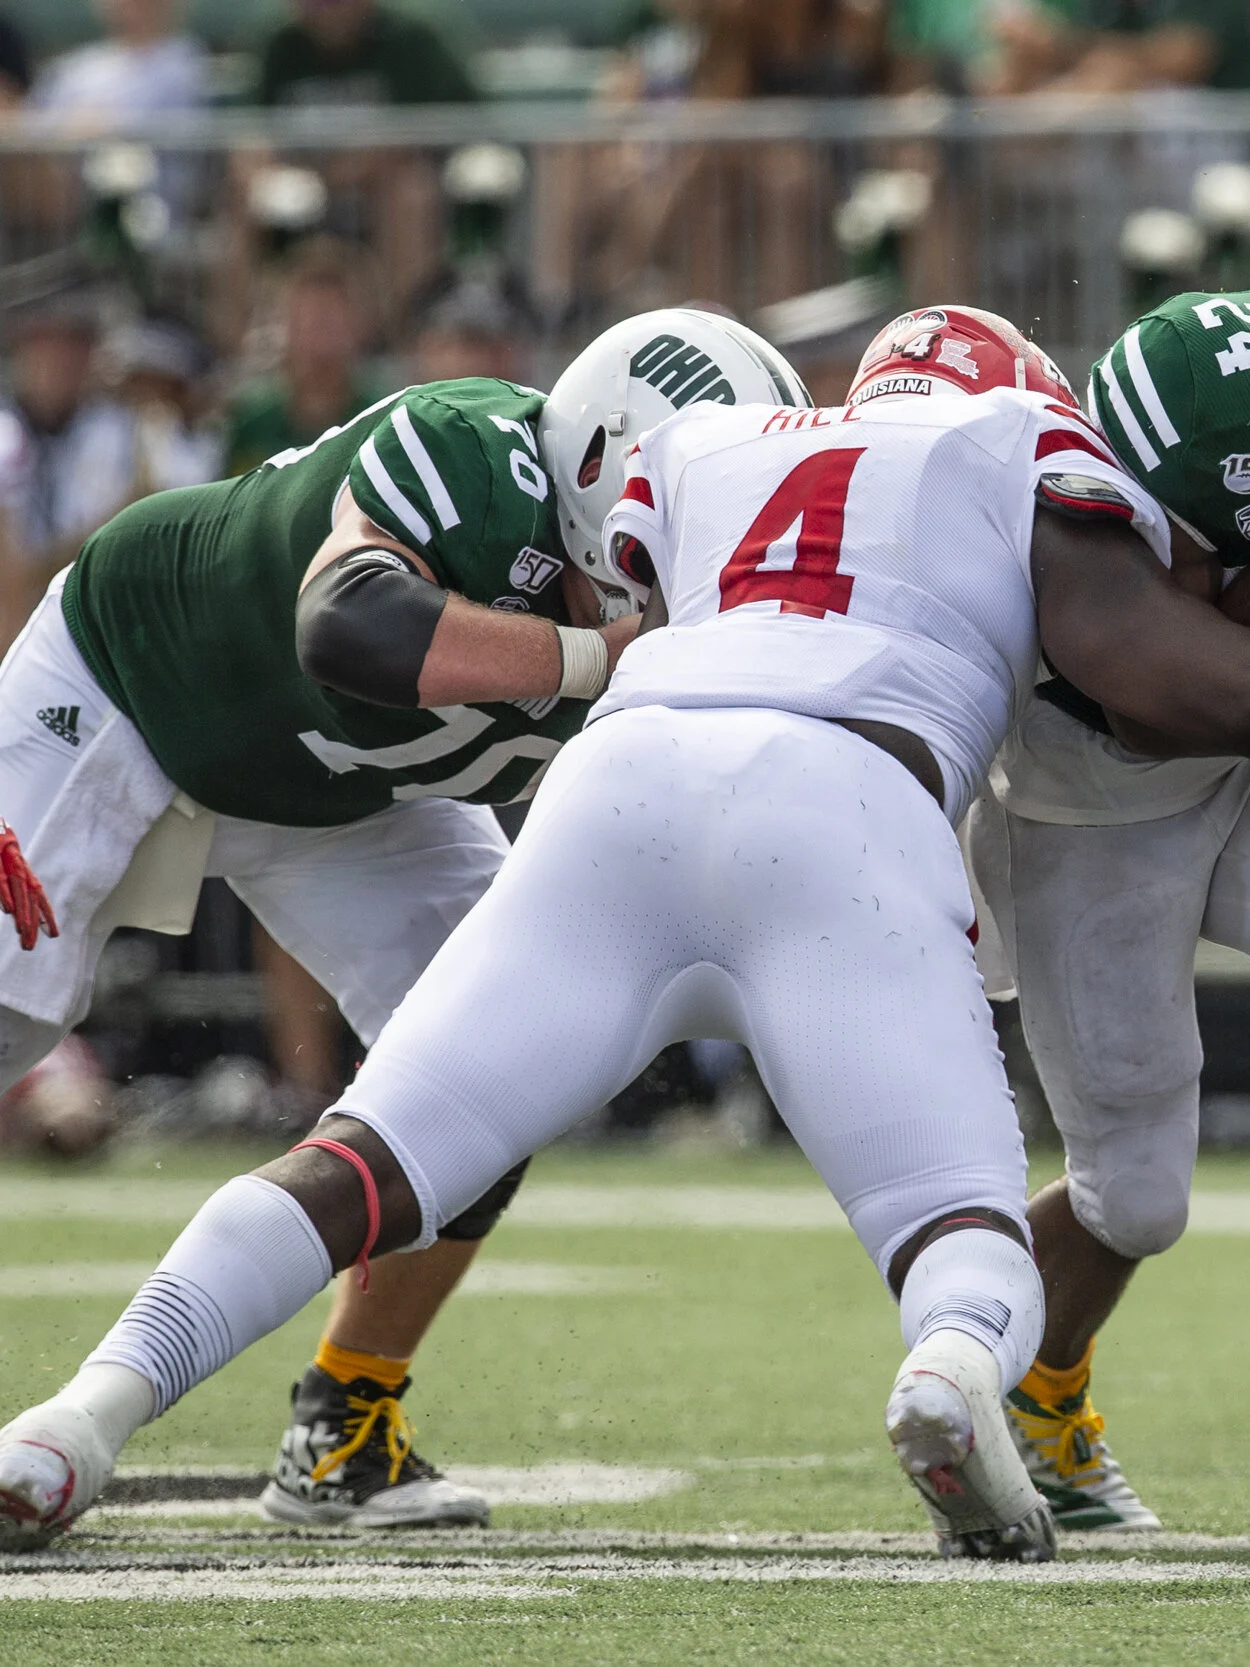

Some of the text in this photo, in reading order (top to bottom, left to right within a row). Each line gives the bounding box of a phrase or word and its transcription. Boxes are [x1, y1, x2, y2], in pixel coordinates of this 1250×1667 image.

[902, 332, 934, 358] 4
[847, 377, 932, 407] OUISIANA
[718, 446, 868, 619] 4
[36, 708, 81, 747] adidas
